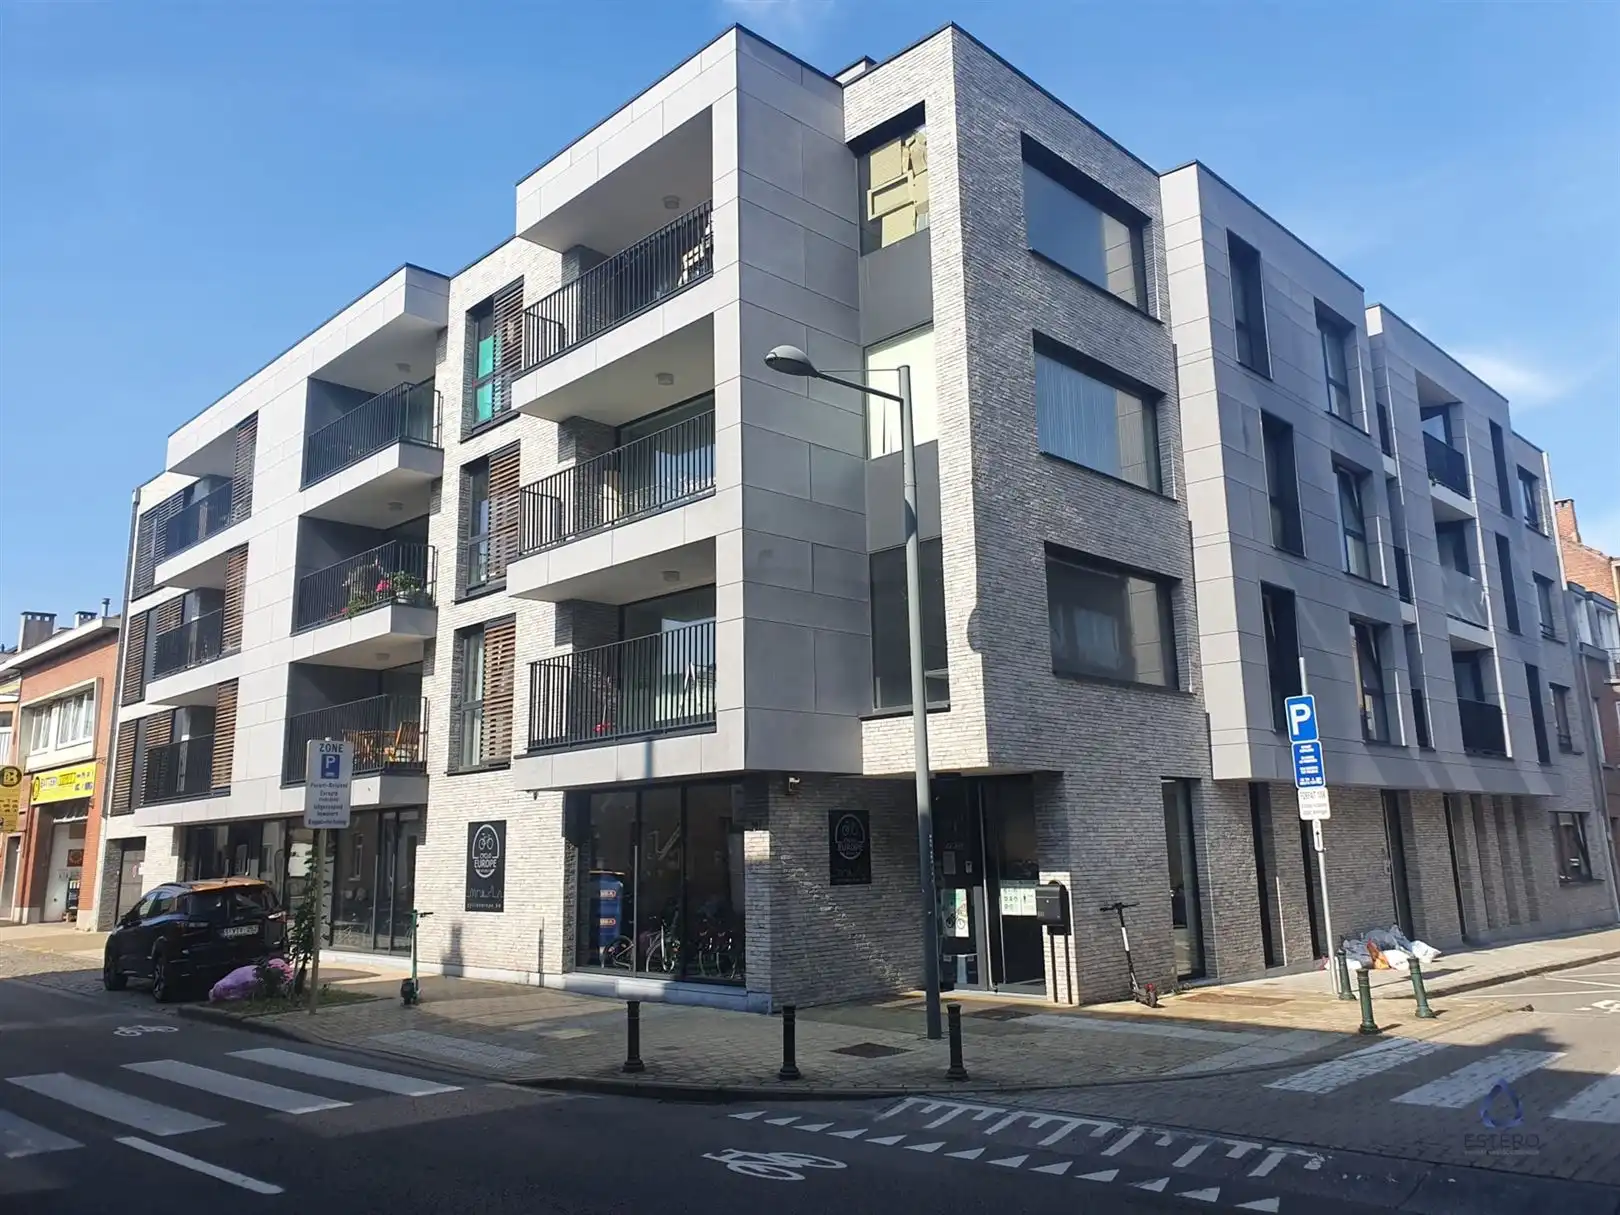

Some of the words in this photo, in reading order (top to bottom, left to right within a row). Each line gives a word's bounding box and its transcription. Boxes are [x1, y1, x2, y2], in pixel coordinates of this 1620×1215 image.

[1289, 703, 1311, 736] P
[319, 743, 344, 753] ZONE
[325, 755, 336, 769] P
[474, 859, 497, 868] EUROPE
